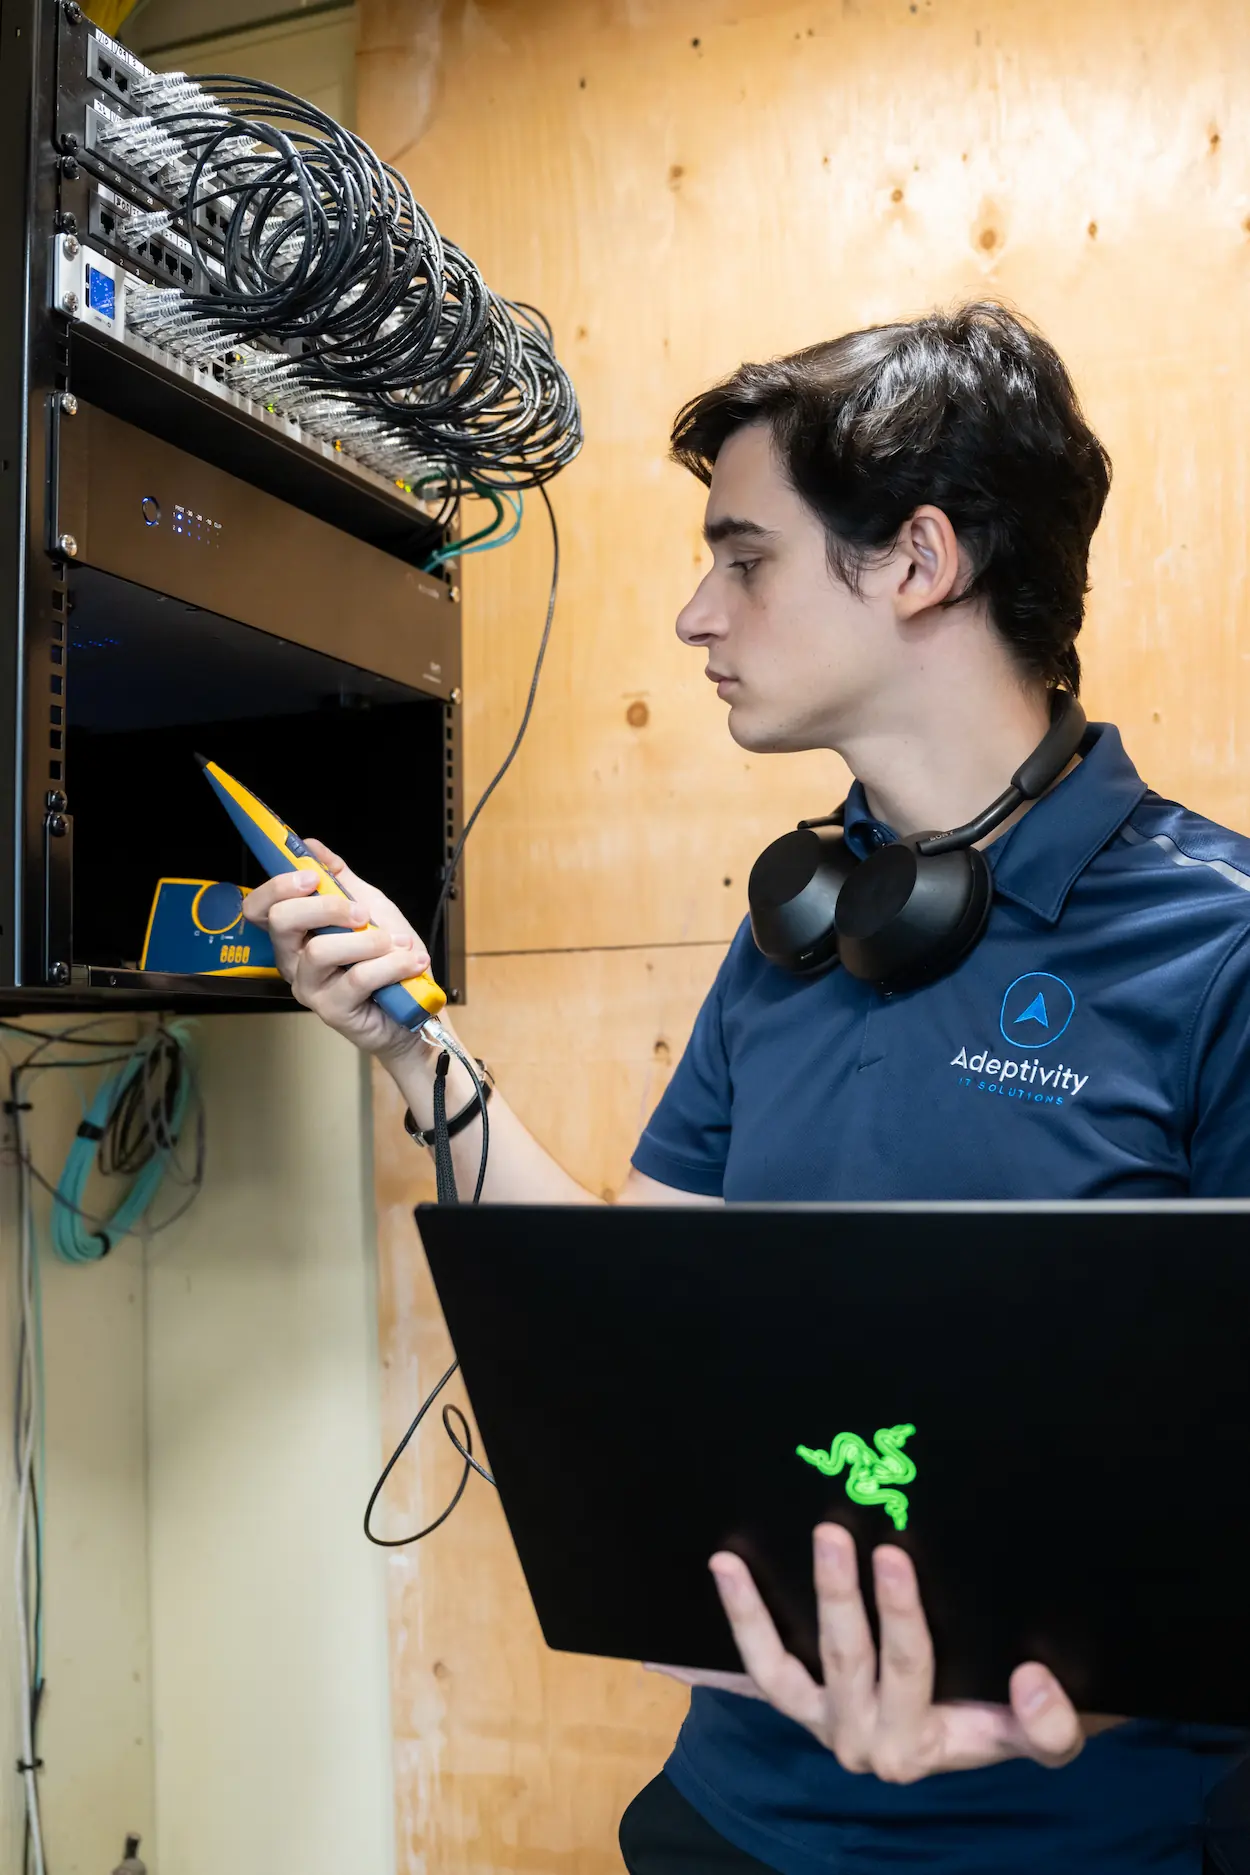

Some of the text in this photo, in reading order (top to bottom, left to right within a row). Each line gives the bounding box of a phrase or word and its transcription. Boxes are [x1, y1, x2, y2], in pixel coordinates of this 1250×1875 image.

[135, 268, 140, 276] 3
[950, 1046, 1089, 1096] Adeptivity
[958, 1077, 1064, 1106] IT SOLUTIONS
